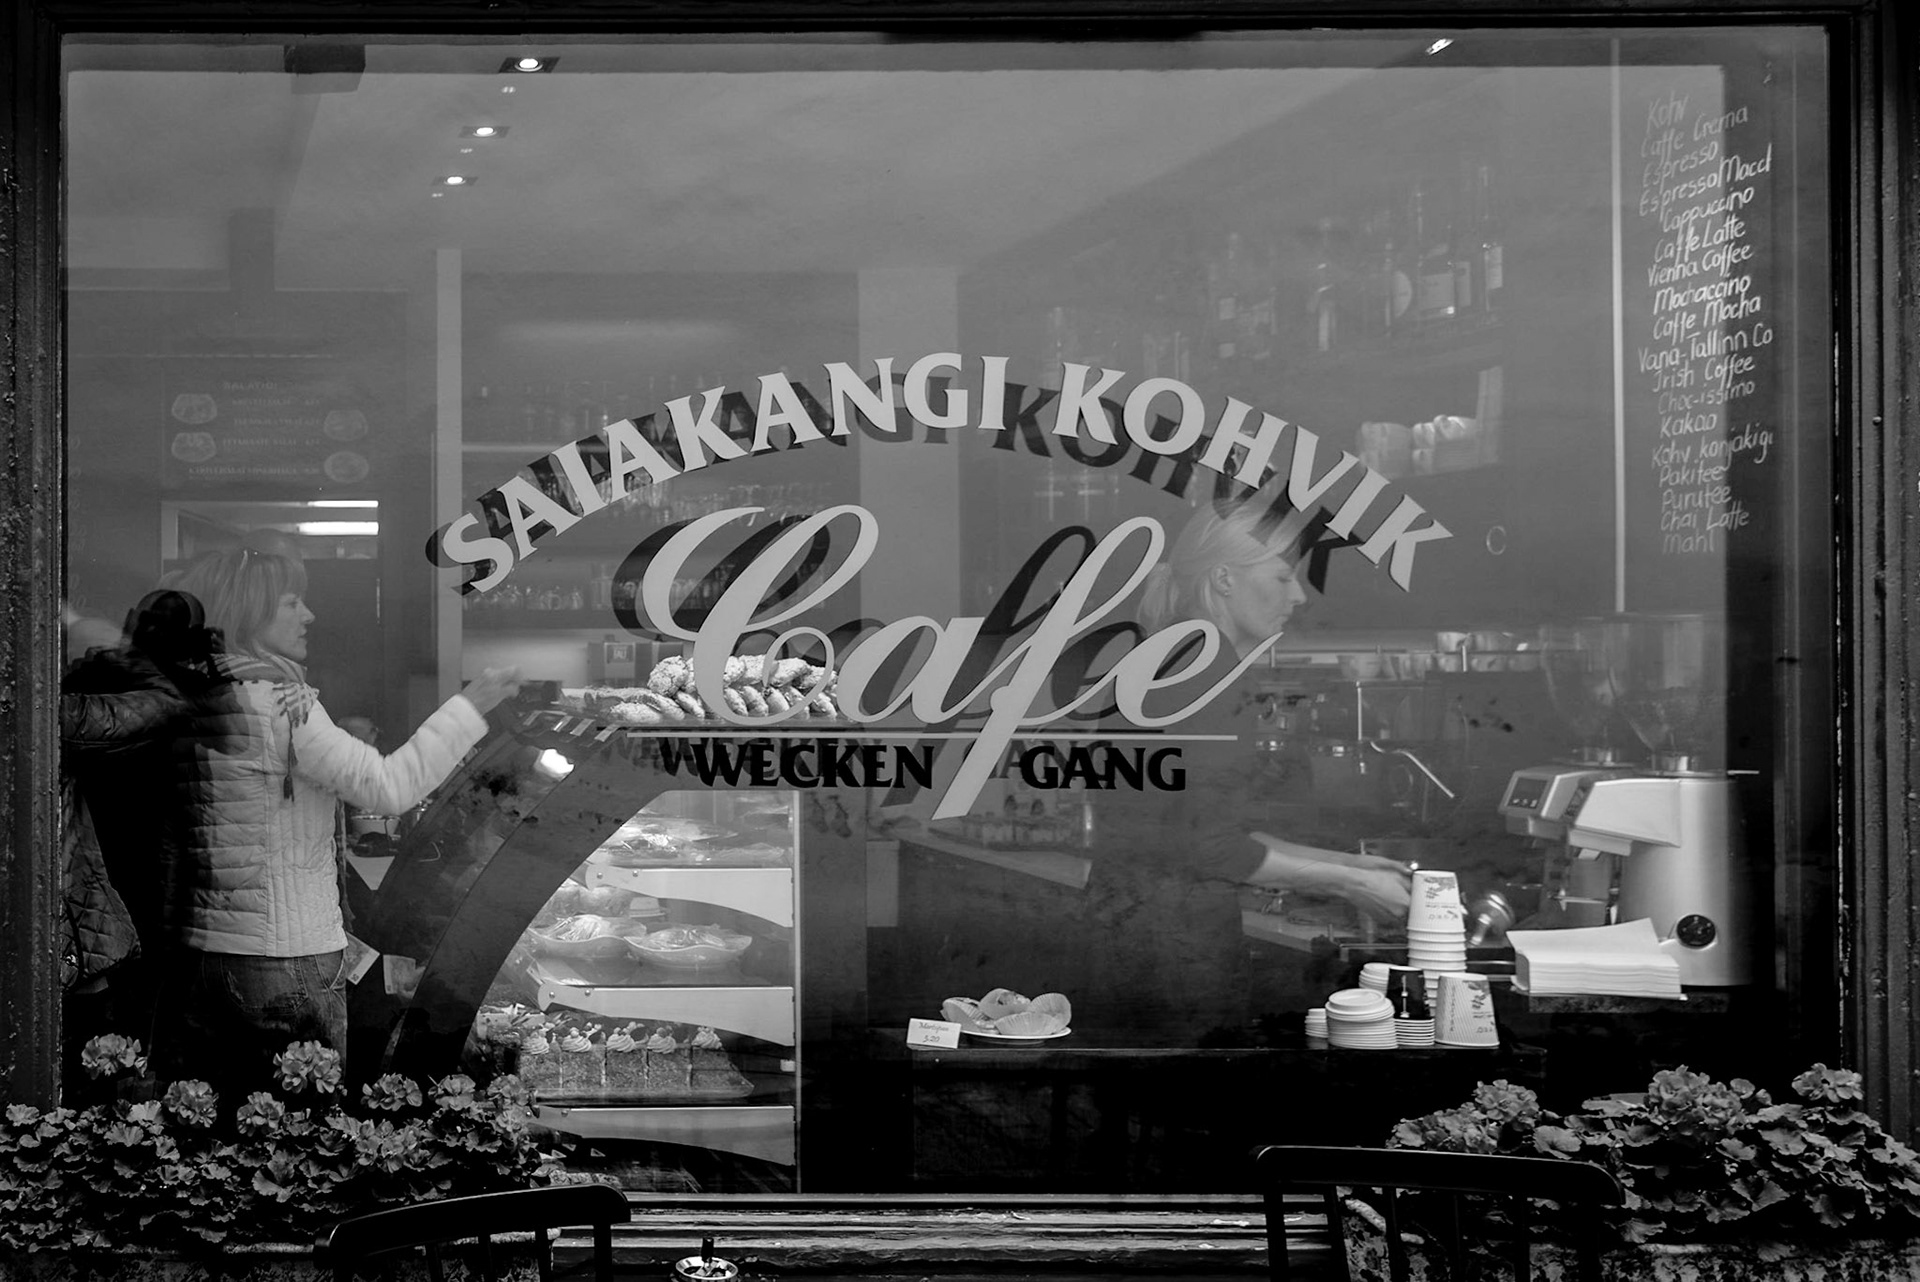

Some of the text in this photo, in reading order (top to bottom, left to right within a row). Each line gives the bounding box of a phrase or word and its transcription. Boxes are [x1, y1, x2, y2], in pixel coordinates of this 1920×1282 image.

[1693, 105, 1748, 141] Crema
[1643, 141, 1718, 194] Espresso
[1639, 172, 1718, 222] Espresso
[1663, 186, 1755, 248] Cappuccino
[1702, 213, 1746, 248] Latte
[1648, 243, 1754, 287] Vienna Coffee
[1703, 294, 1762, 328] Mocha
[1704, 353, 1756, 390] Coffee
[1659, 411, 1718, 439] Kakao
[442, 352, 1454, 593] SAIAKANGI KOHVIK
[1706, 500, 1750, 531] Latte
[641, 504, 1285, 820] Cafe
[692, 743, 1187, 792] WECKEN GANG
